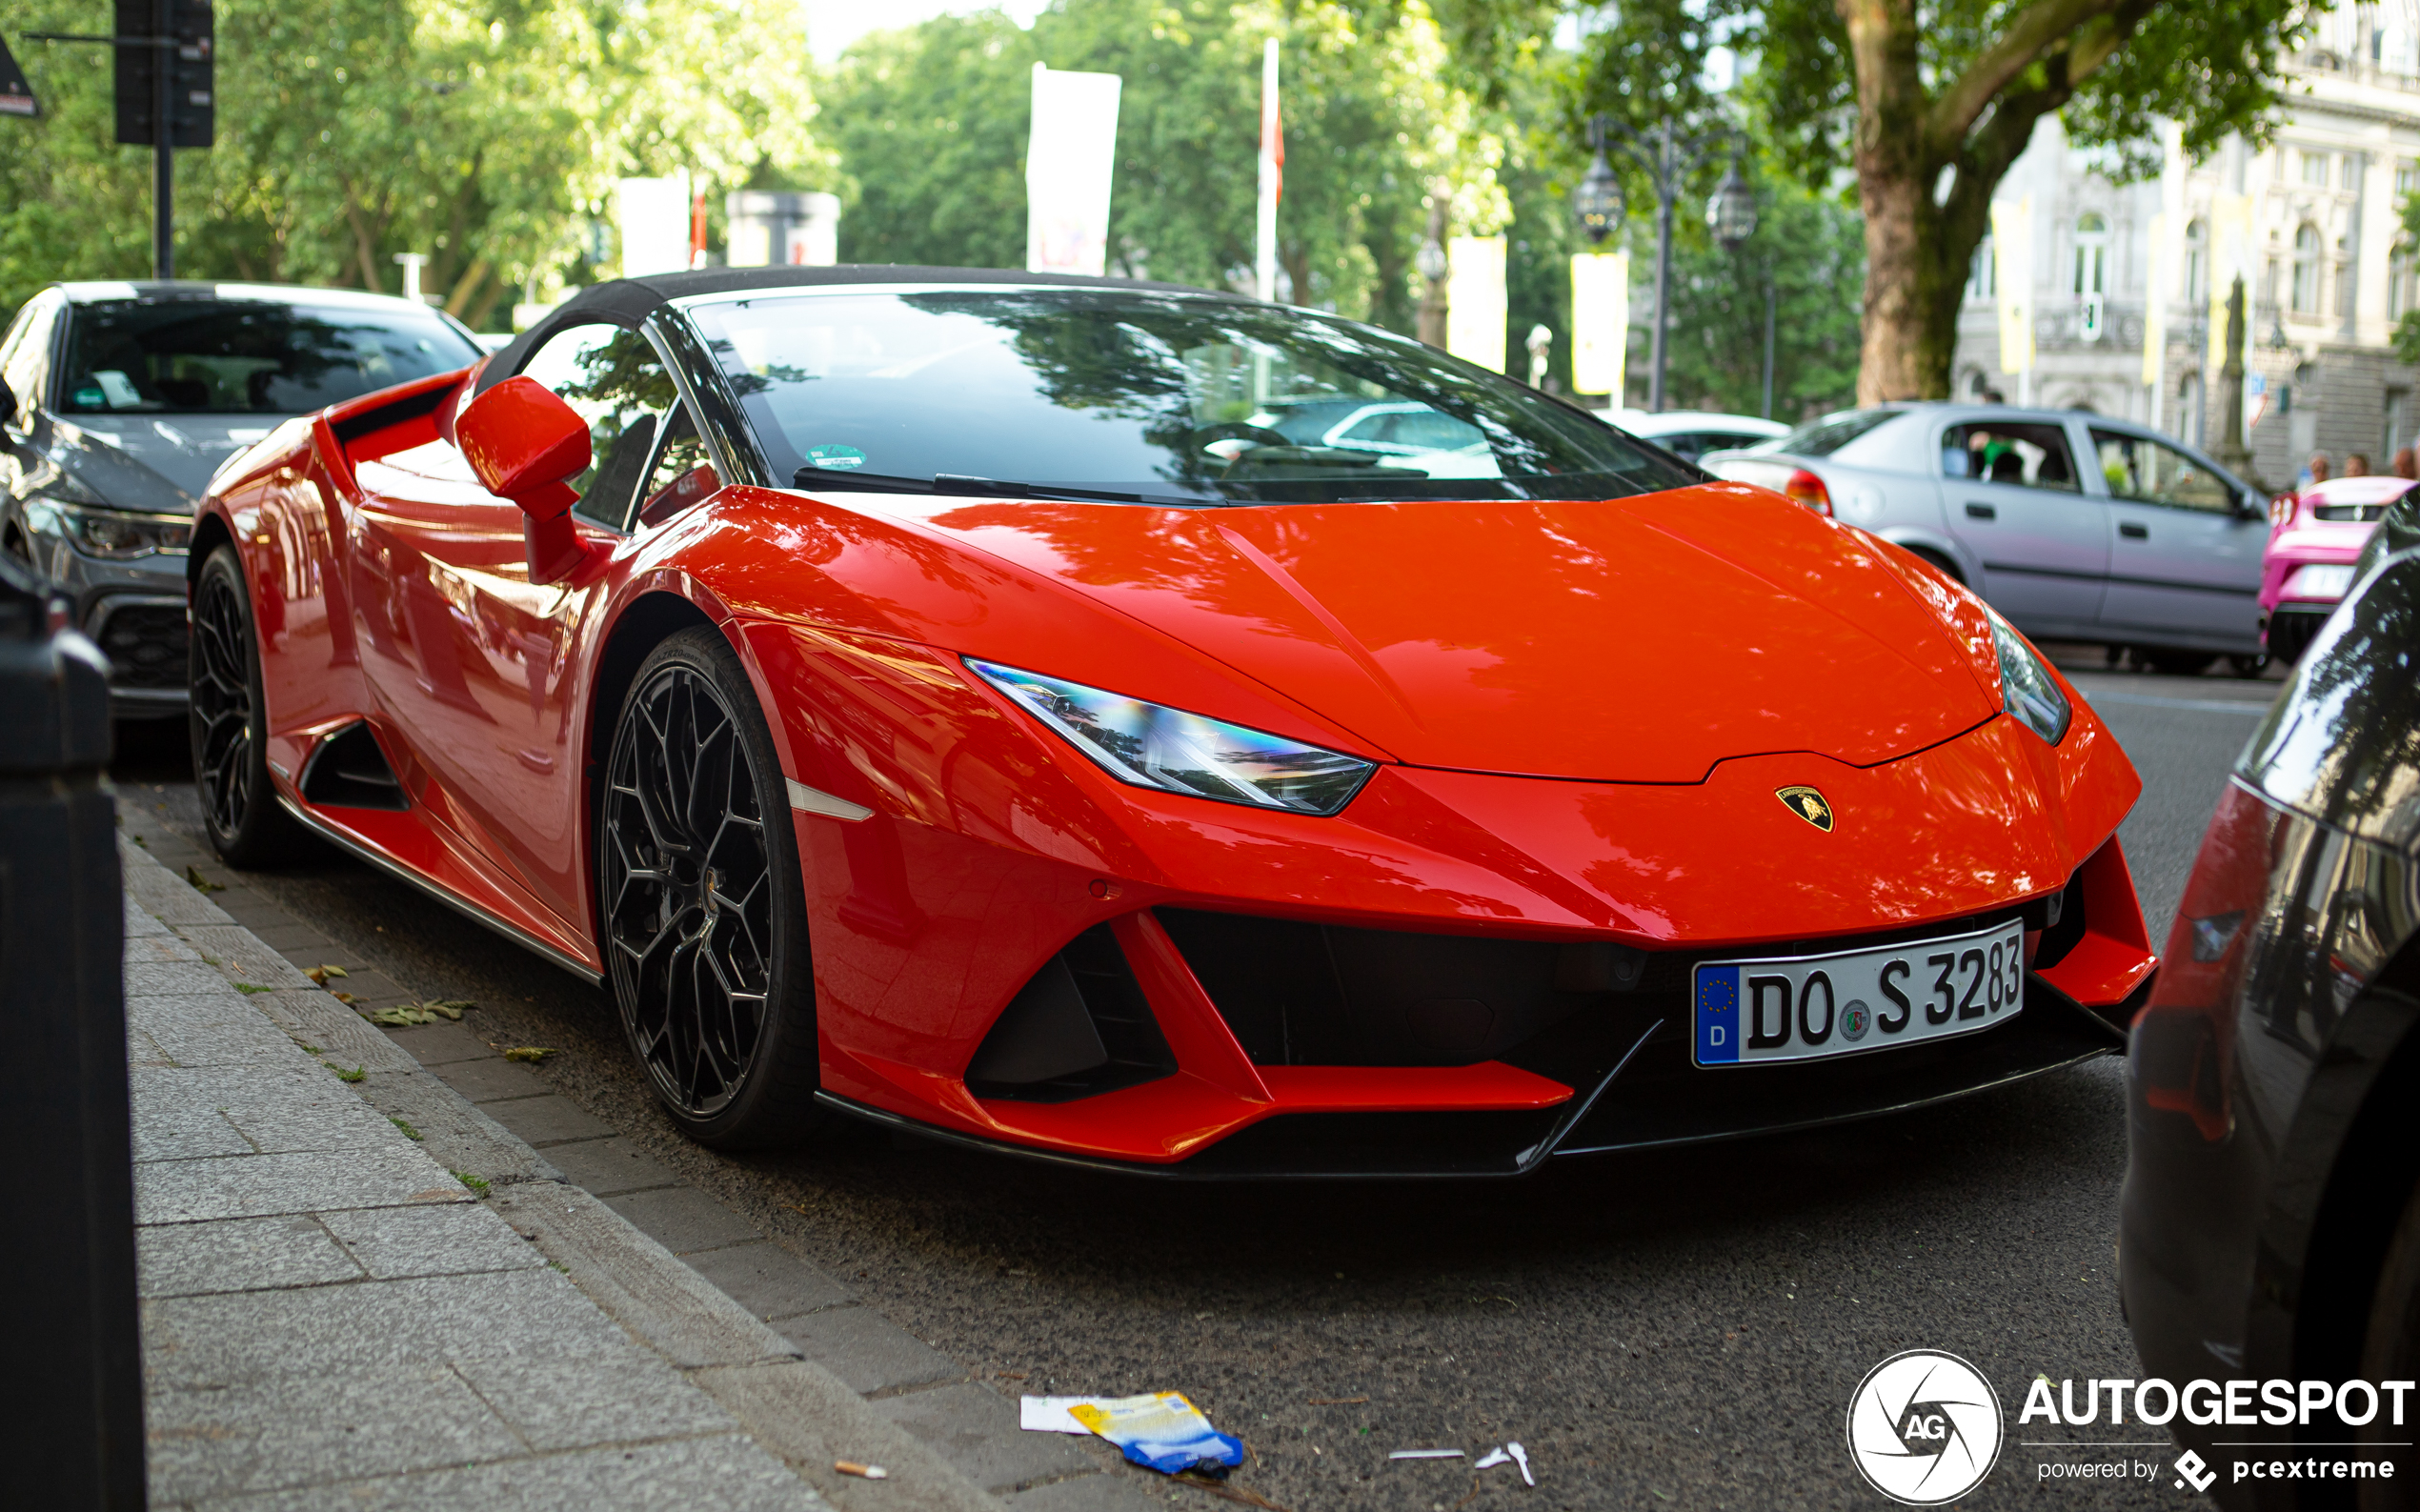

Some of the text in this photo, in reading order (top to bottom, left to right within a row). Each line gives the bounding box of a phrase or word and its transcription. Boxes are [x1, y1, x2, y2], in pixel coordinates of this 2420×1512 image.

[1747, 933, 2021, 1049] DO S 3283
[1710, 1025, 1725, 1046] D
